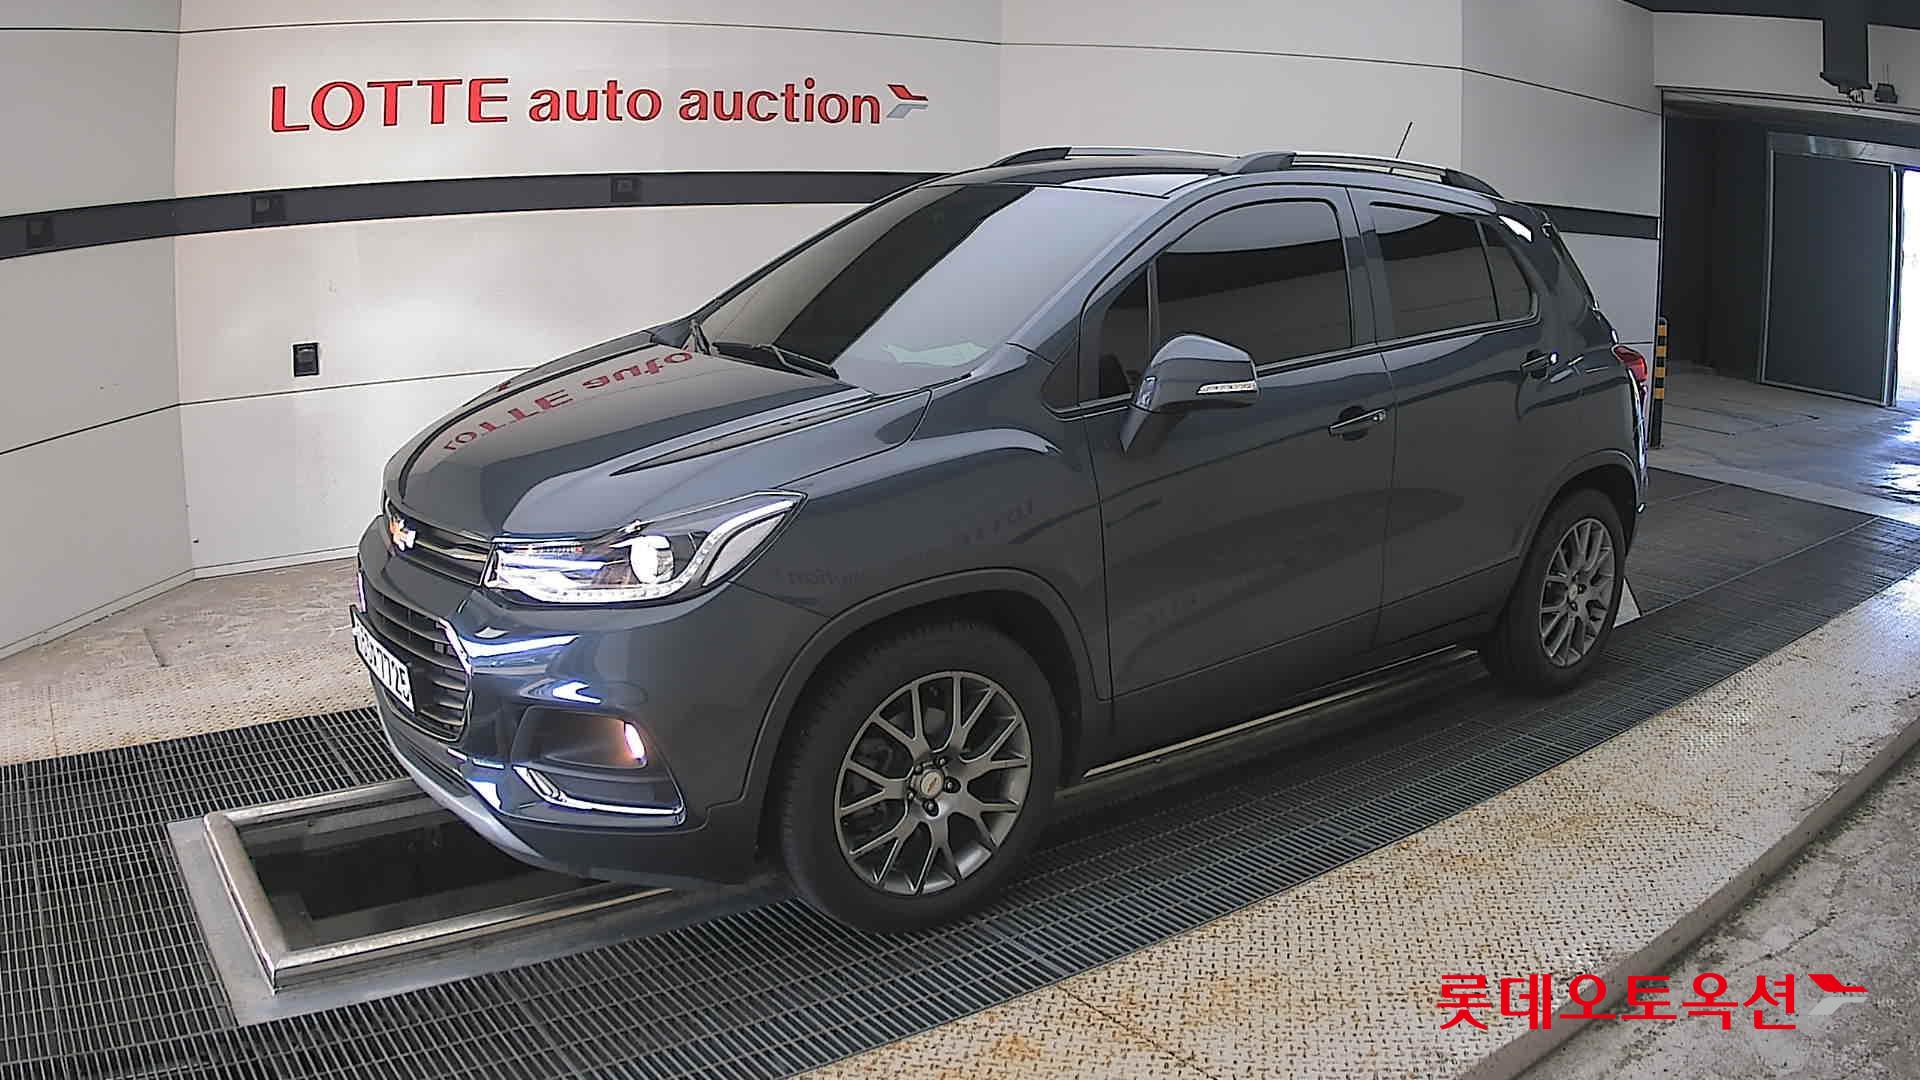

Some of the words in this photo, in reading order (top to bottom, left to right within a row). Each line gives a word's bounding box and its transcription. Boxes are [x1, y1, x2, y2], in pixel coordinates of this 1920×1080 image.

[271, 78, 508, 133] LOTTE
[528, 79, 663, 122] auto
[678, 78, 881, 124] auction
